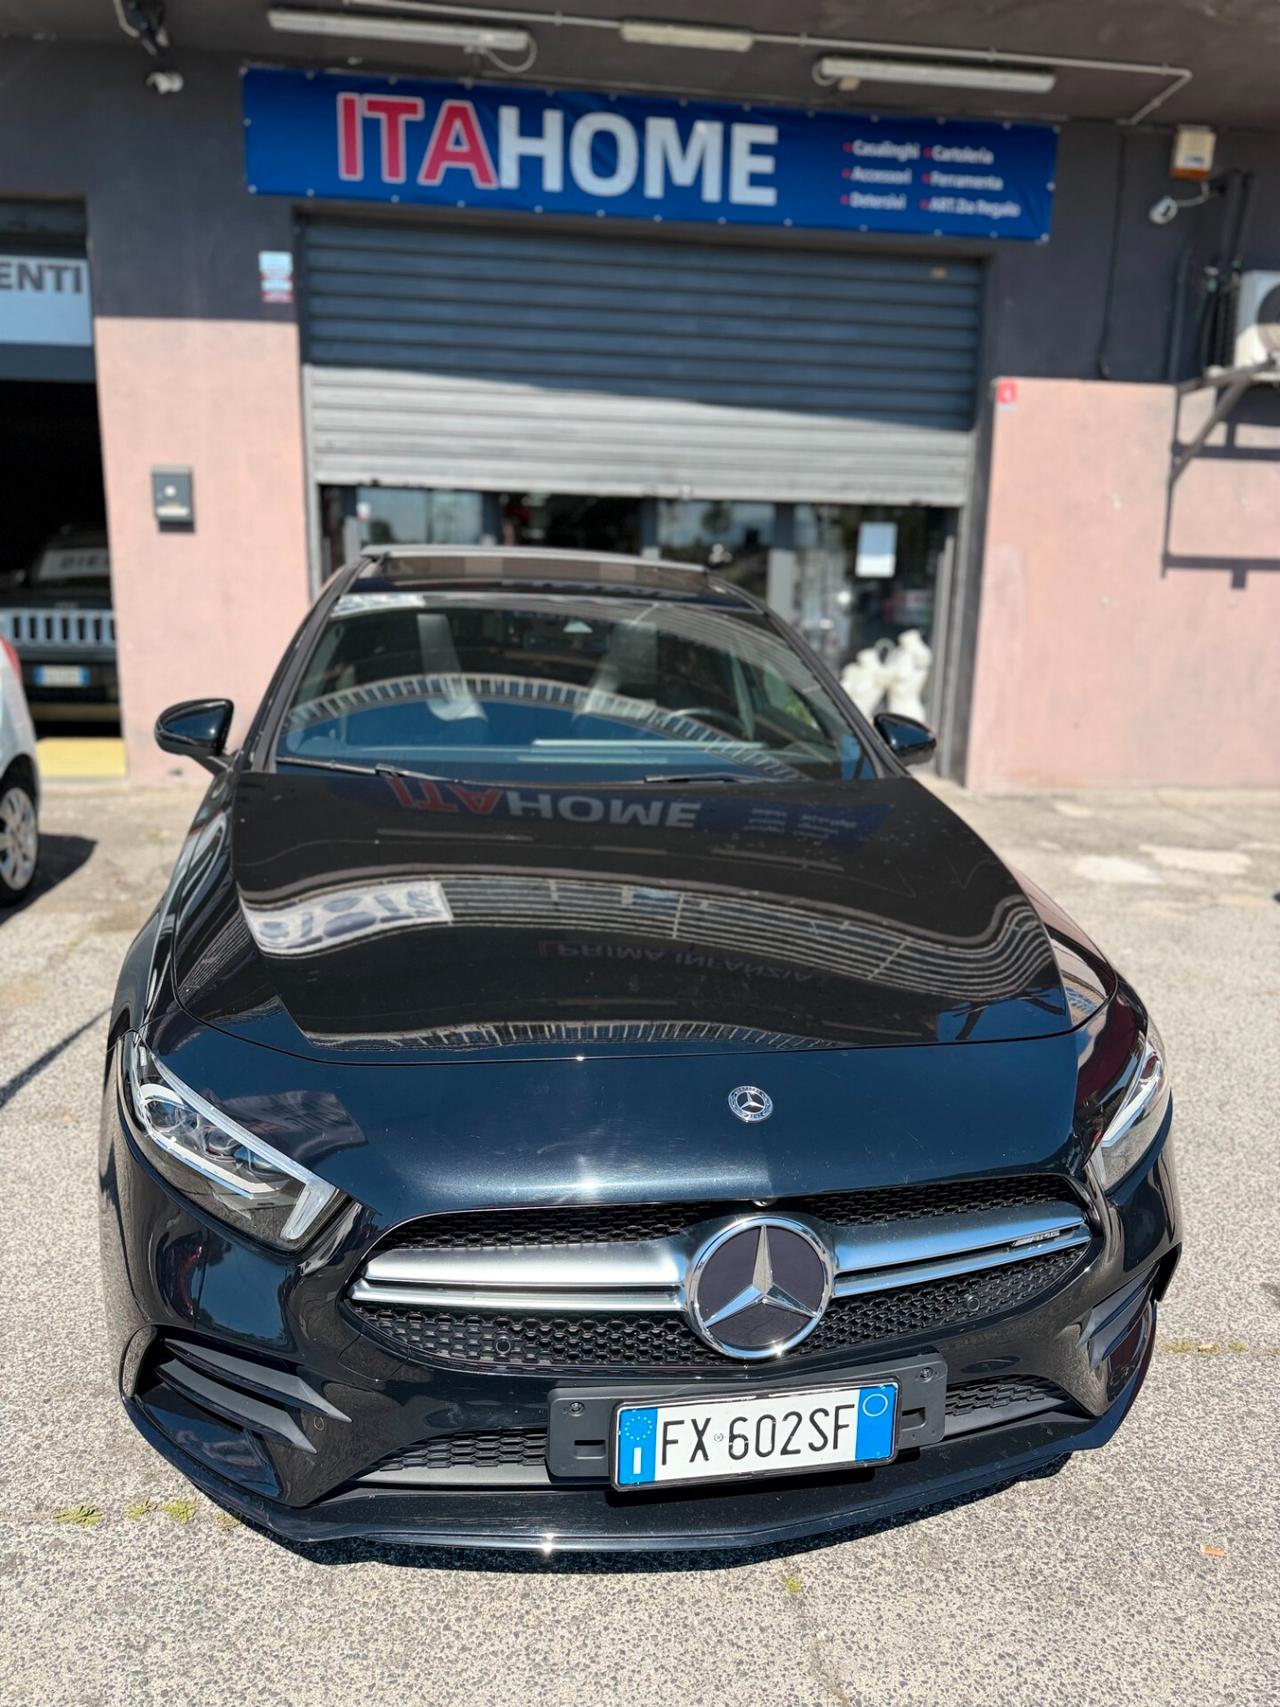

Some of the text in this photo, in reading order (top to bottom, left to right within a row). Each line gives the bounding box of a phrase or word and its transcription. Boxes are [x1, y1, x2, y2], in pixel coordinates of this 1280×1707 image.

[336, 92, 778, 206] ITAHOME
[853, 140, 920, 162] Casalinghi
[932, 146, 994, 165] Cartoleria
[851, 166, 912, 184] Accessori
[850, 192, 907, 210] Detersivi
[661, 1403, 856, 1466] FX 602SF
